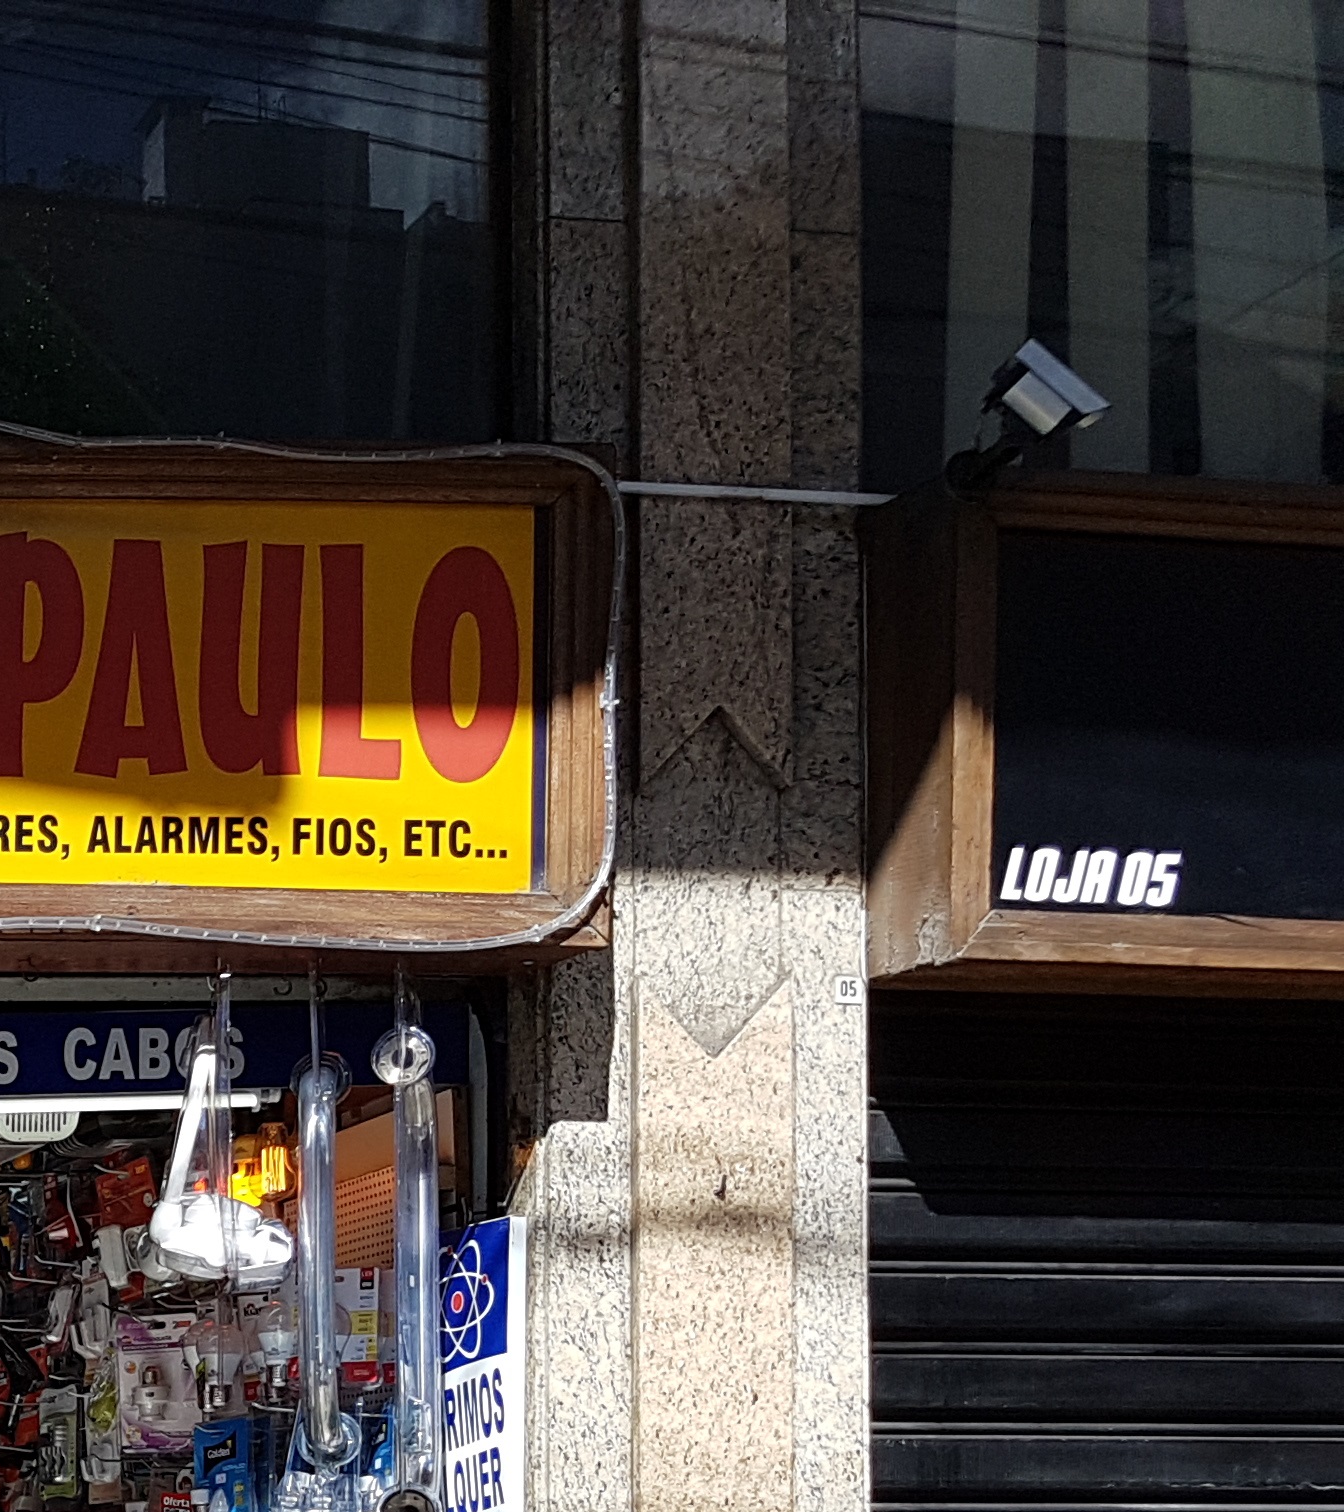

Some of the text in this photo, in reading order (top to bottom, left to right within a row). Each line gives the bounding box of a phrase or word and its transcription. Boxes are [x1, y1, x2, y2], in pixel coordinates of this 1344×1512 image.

[87, 814, 281, 862] ALARMES,
[291, 816, 390, 865] FIOS,
[402, 819, 509, 862] ETC...
[999, 844, 1183, 907] LOJA 05
[840, 979, 858, 998] 05
[443, 1367, 505, 1452] RIMOS
[162, 1496, 191, 1508] Oferta
